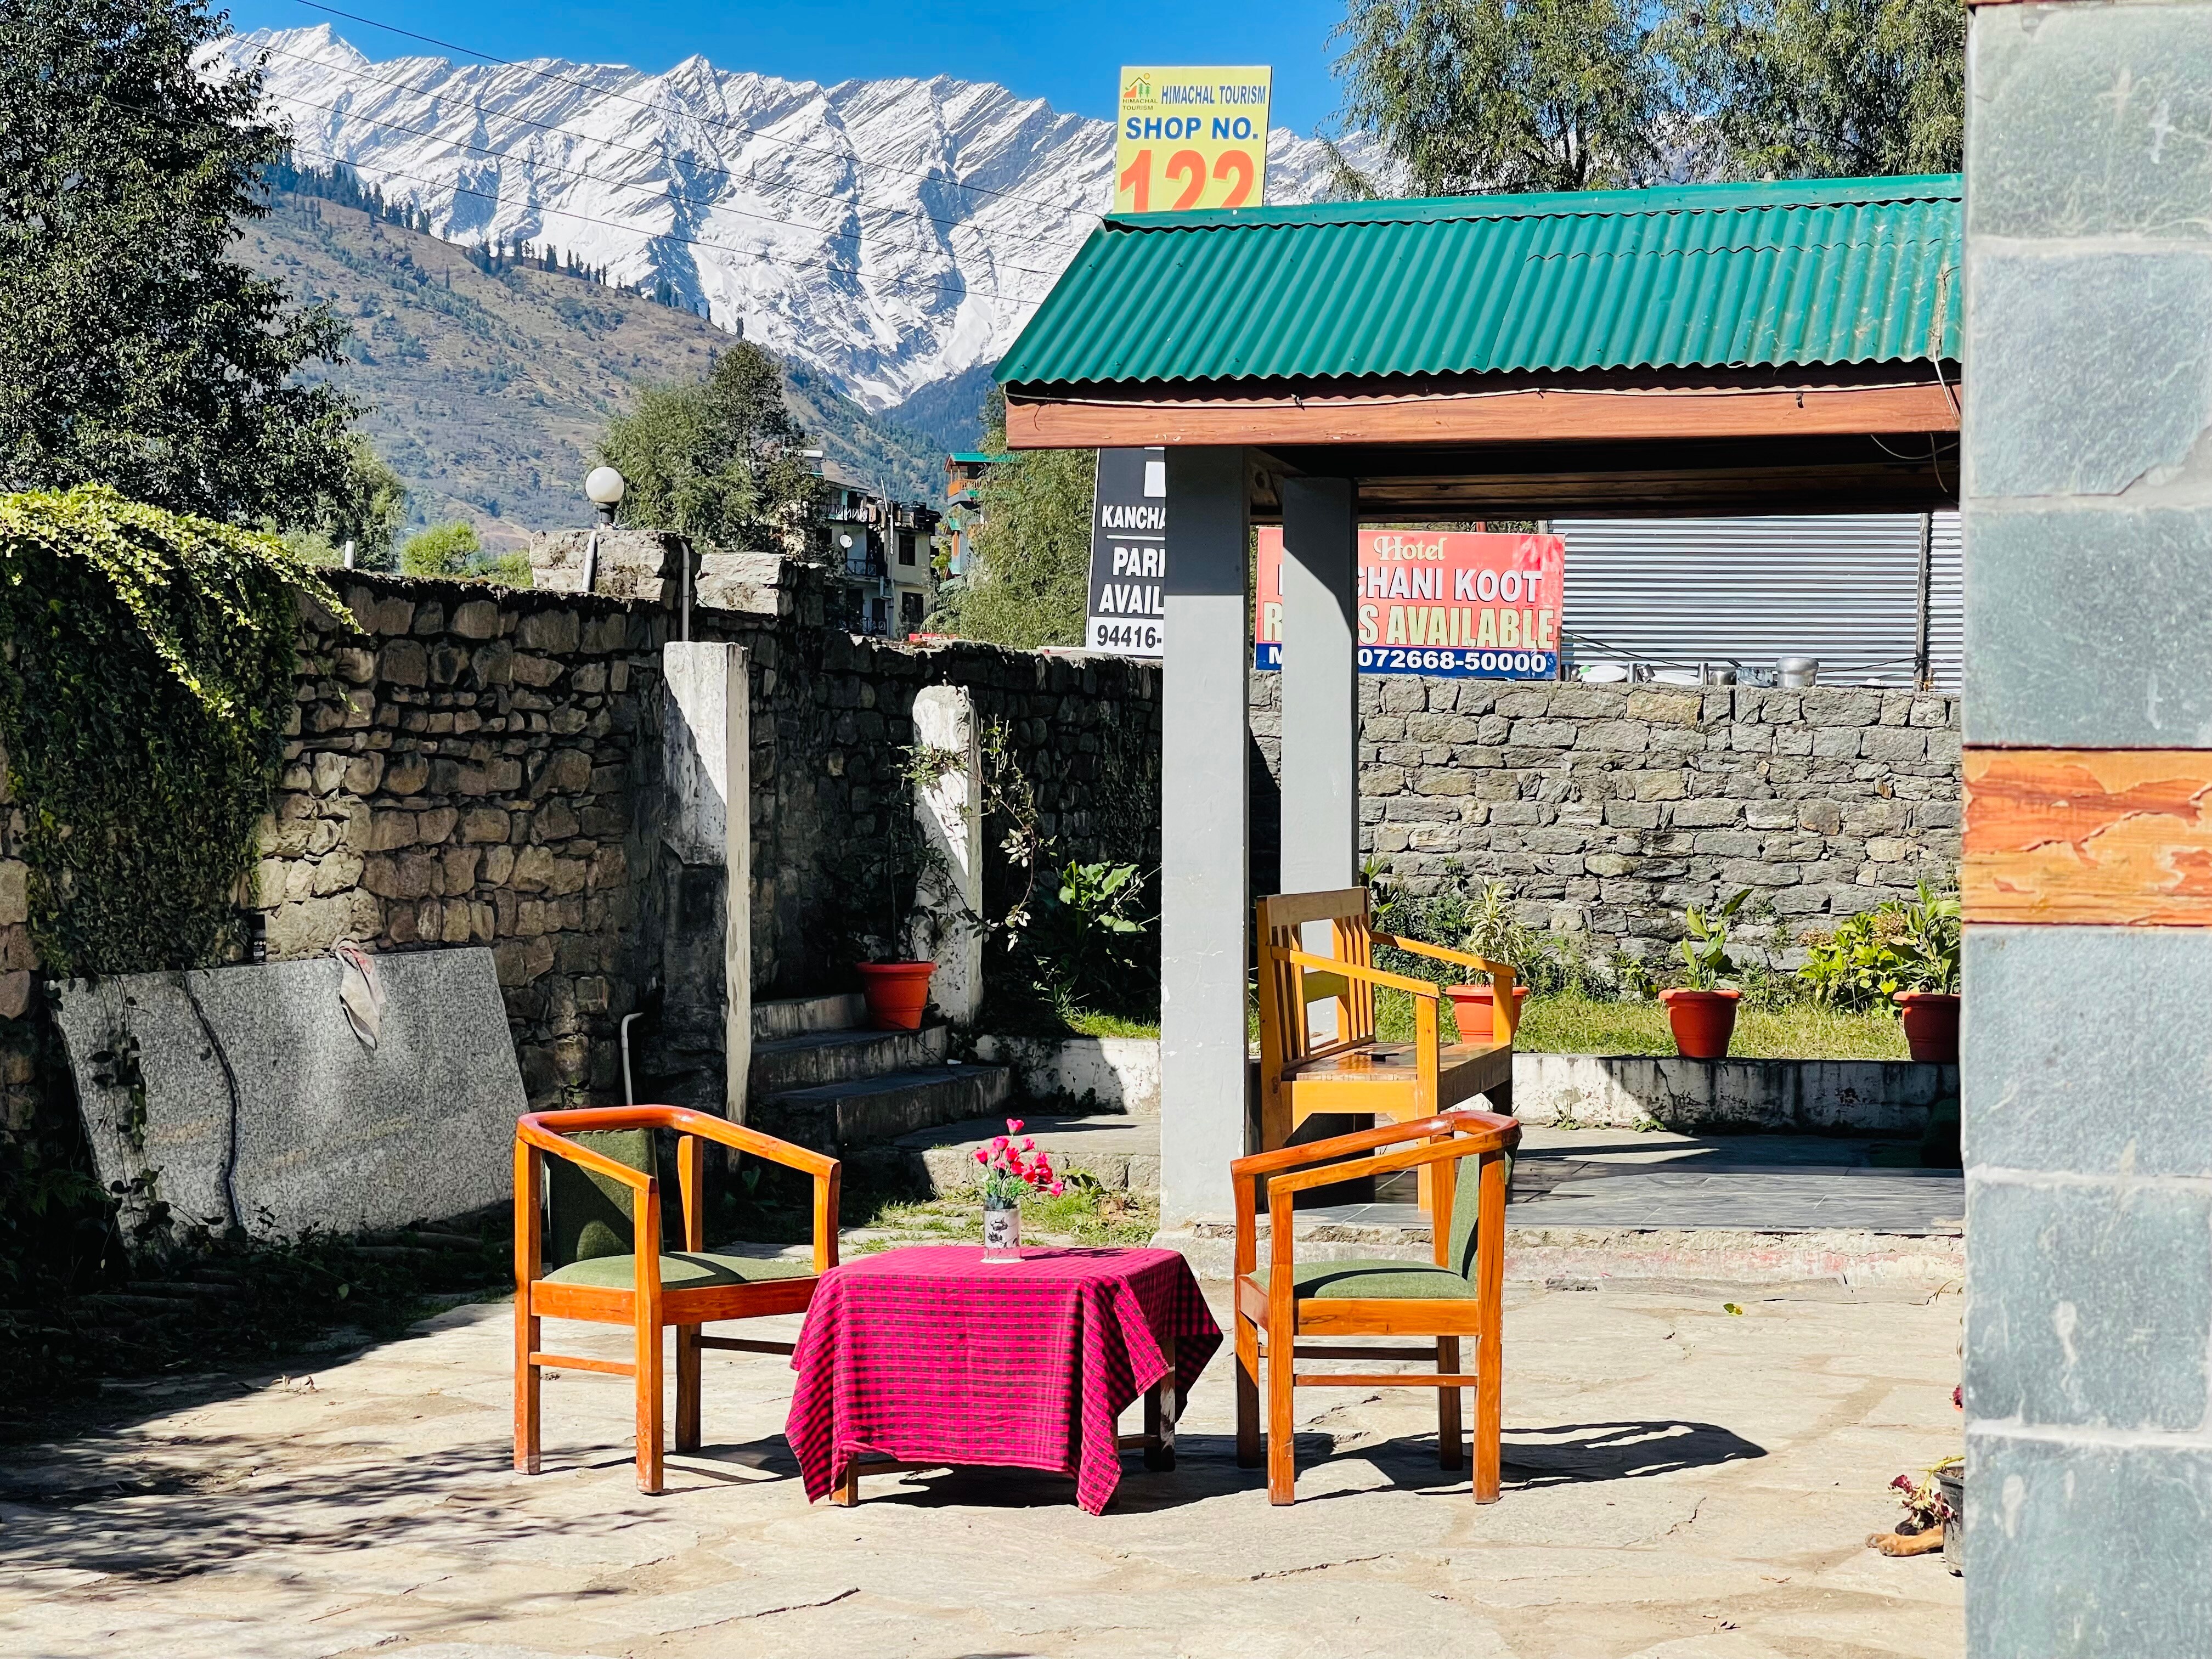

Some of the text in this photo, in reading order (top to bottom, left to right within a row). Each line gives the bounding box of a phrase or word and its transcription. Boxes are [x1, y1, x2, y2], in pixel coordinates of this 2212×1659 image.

[1161, 86, 1266, 104] HIMACHAL TOURISM
[1125, 117, 1259, 140] SHOP NO.
[1120, 150, 1255, 212] 122
[1102, 505, 1166, 529] KANCHA
[1373, 536, 1448, 561] Hotel
[1113, 546, 1166, 578] PAR
[1454, 568, 1542, 602] KOOT
[1098, 583, 1164, 614] AVAIL
[1097, 624, 1163, 648] 94416-
[1385, 605, 1555, 650] AVAILABLE
[1358, 648, 1547, 673] 072668-50000
